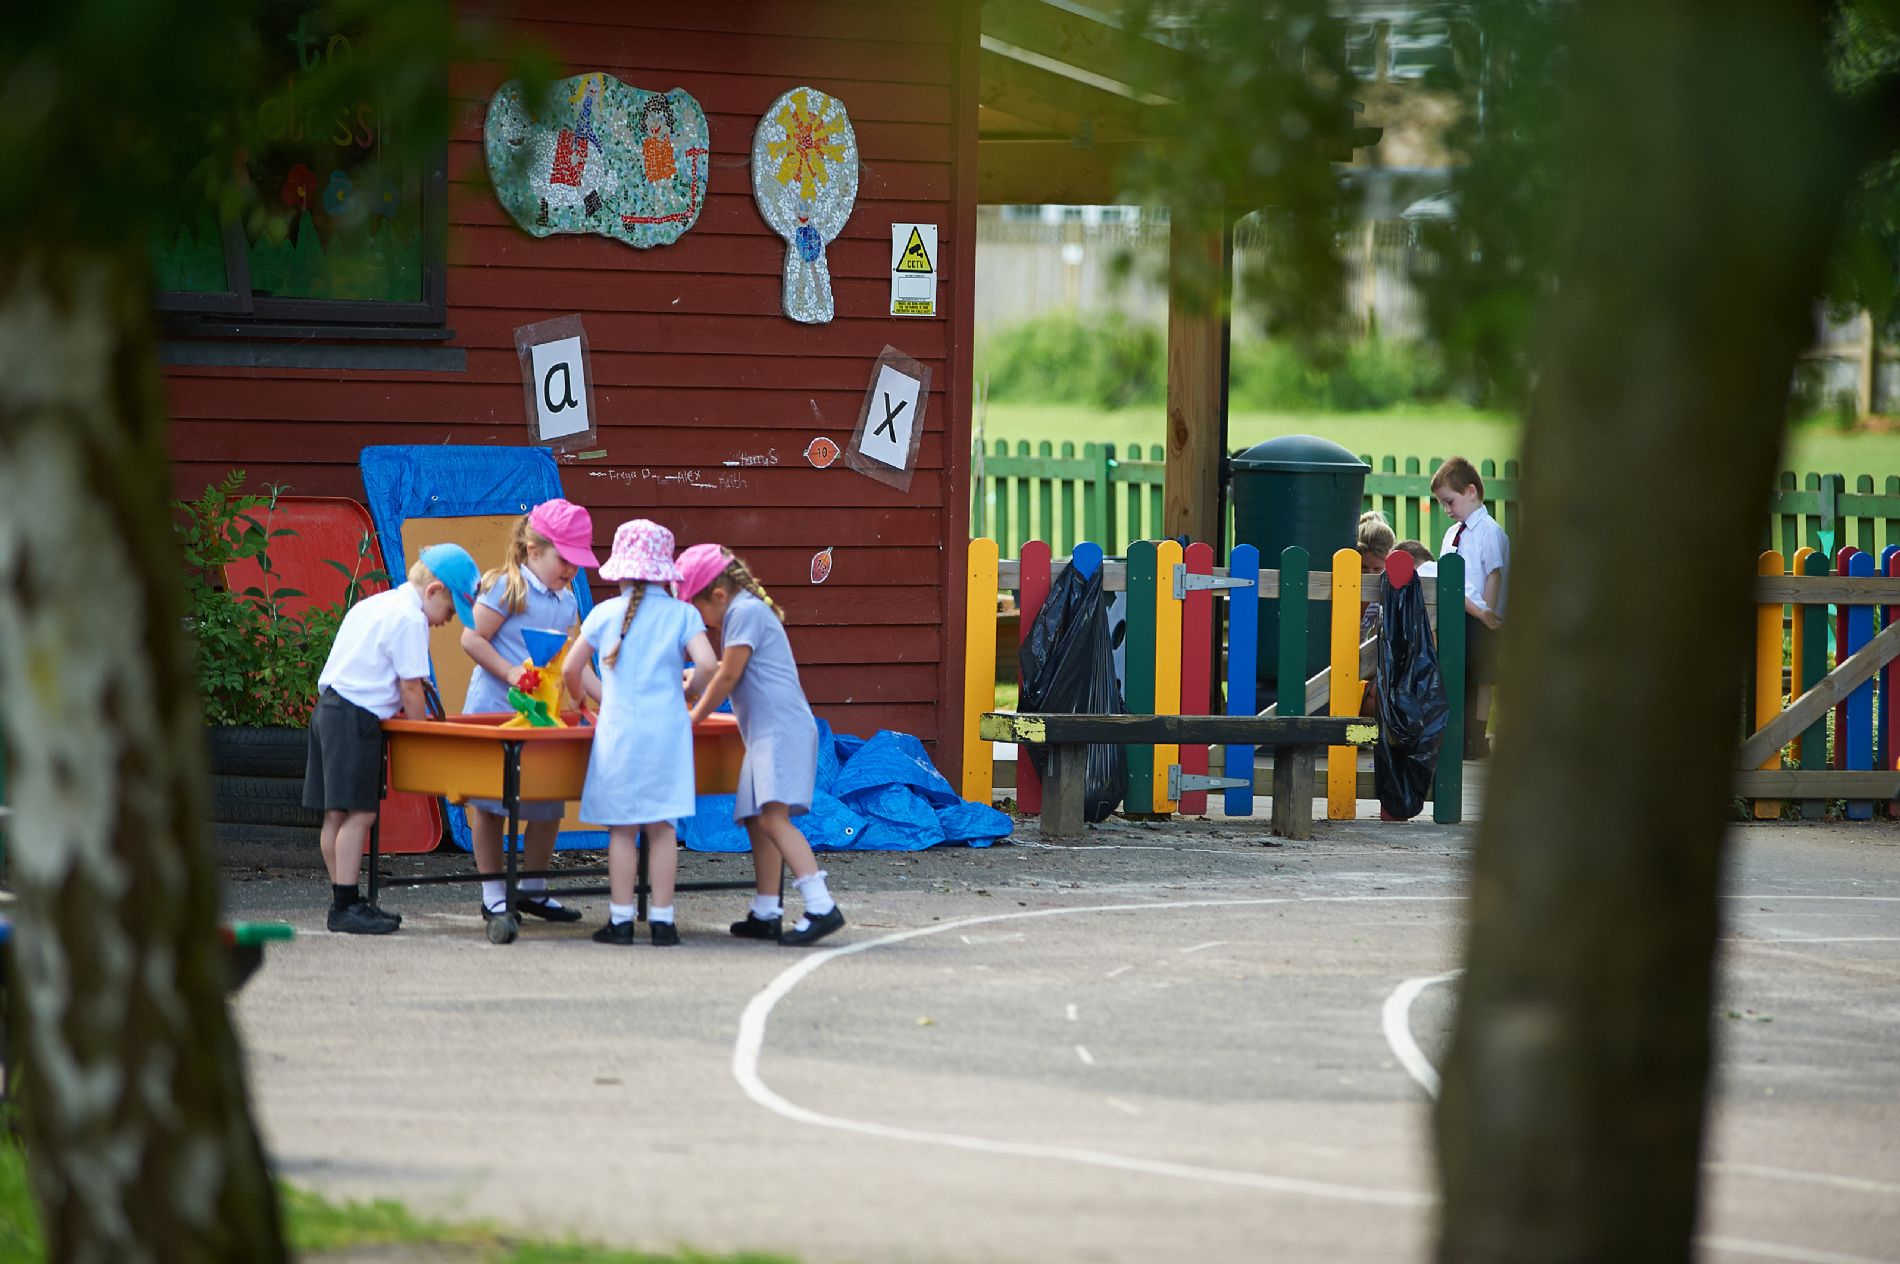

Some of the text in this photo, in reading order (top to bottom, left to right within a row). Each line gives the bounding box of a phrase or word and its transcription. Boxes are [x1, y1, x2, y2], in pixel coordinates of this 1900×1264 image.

[907, 260, 923, 269] CCTV
[543, 361, 579, 414] a
[816, 446, 828, 458] 10
